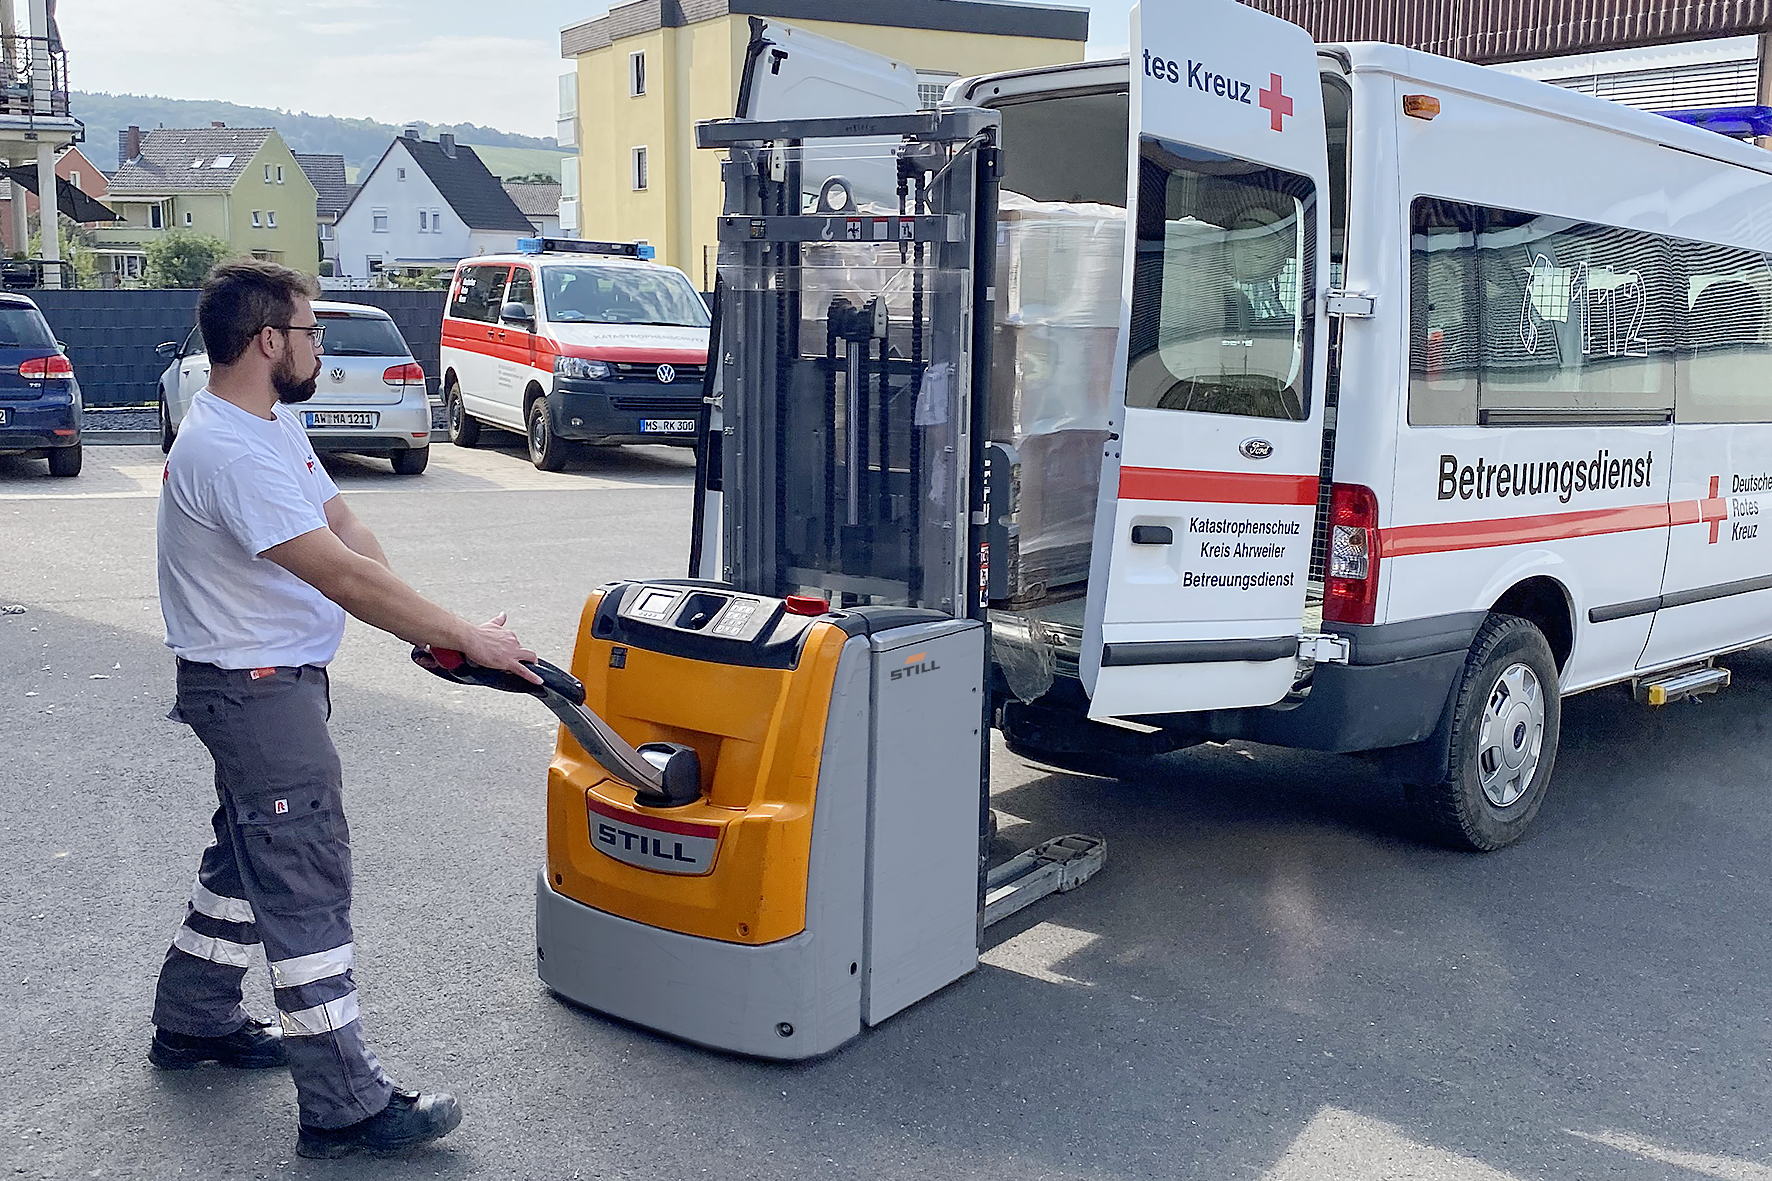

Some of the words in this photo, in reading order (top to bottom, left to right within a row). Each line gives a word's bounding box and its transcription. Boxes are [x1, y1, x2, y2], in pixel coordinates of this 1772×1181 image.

[1143, 49, 1179, 83] tes
[1187, 60, 1251, 104] Kreuz
[1571, 261, 1648, 357] 112
[314, 414, 326, 424] AW
[333, 414, 346, 424] MA
[348, 414, 371, 424] 1211
[645, 421, 658, 431] MS
[663, 421, 676, 431] RK
[677, 421, 694, 431] 300
[1249, 441, 1270, 455] Ford
[1438, 449, 1652, 503] Betreuungsdienst
[1733, 498, 1759, 517] Rotes
[1189, 517, 1300, 537] Katastrophenschutz
[1732, 522, 1758, 541] Kreuz
[1200, 542, 1230, 557] Kreis
[1233, 543, 1285, 558] Ahrweiler
[1182, 571, 1294, 590] Betreuungsdienst
[891, 660, 940, 681] STILL
[599, 823, 696, 863] STILL
